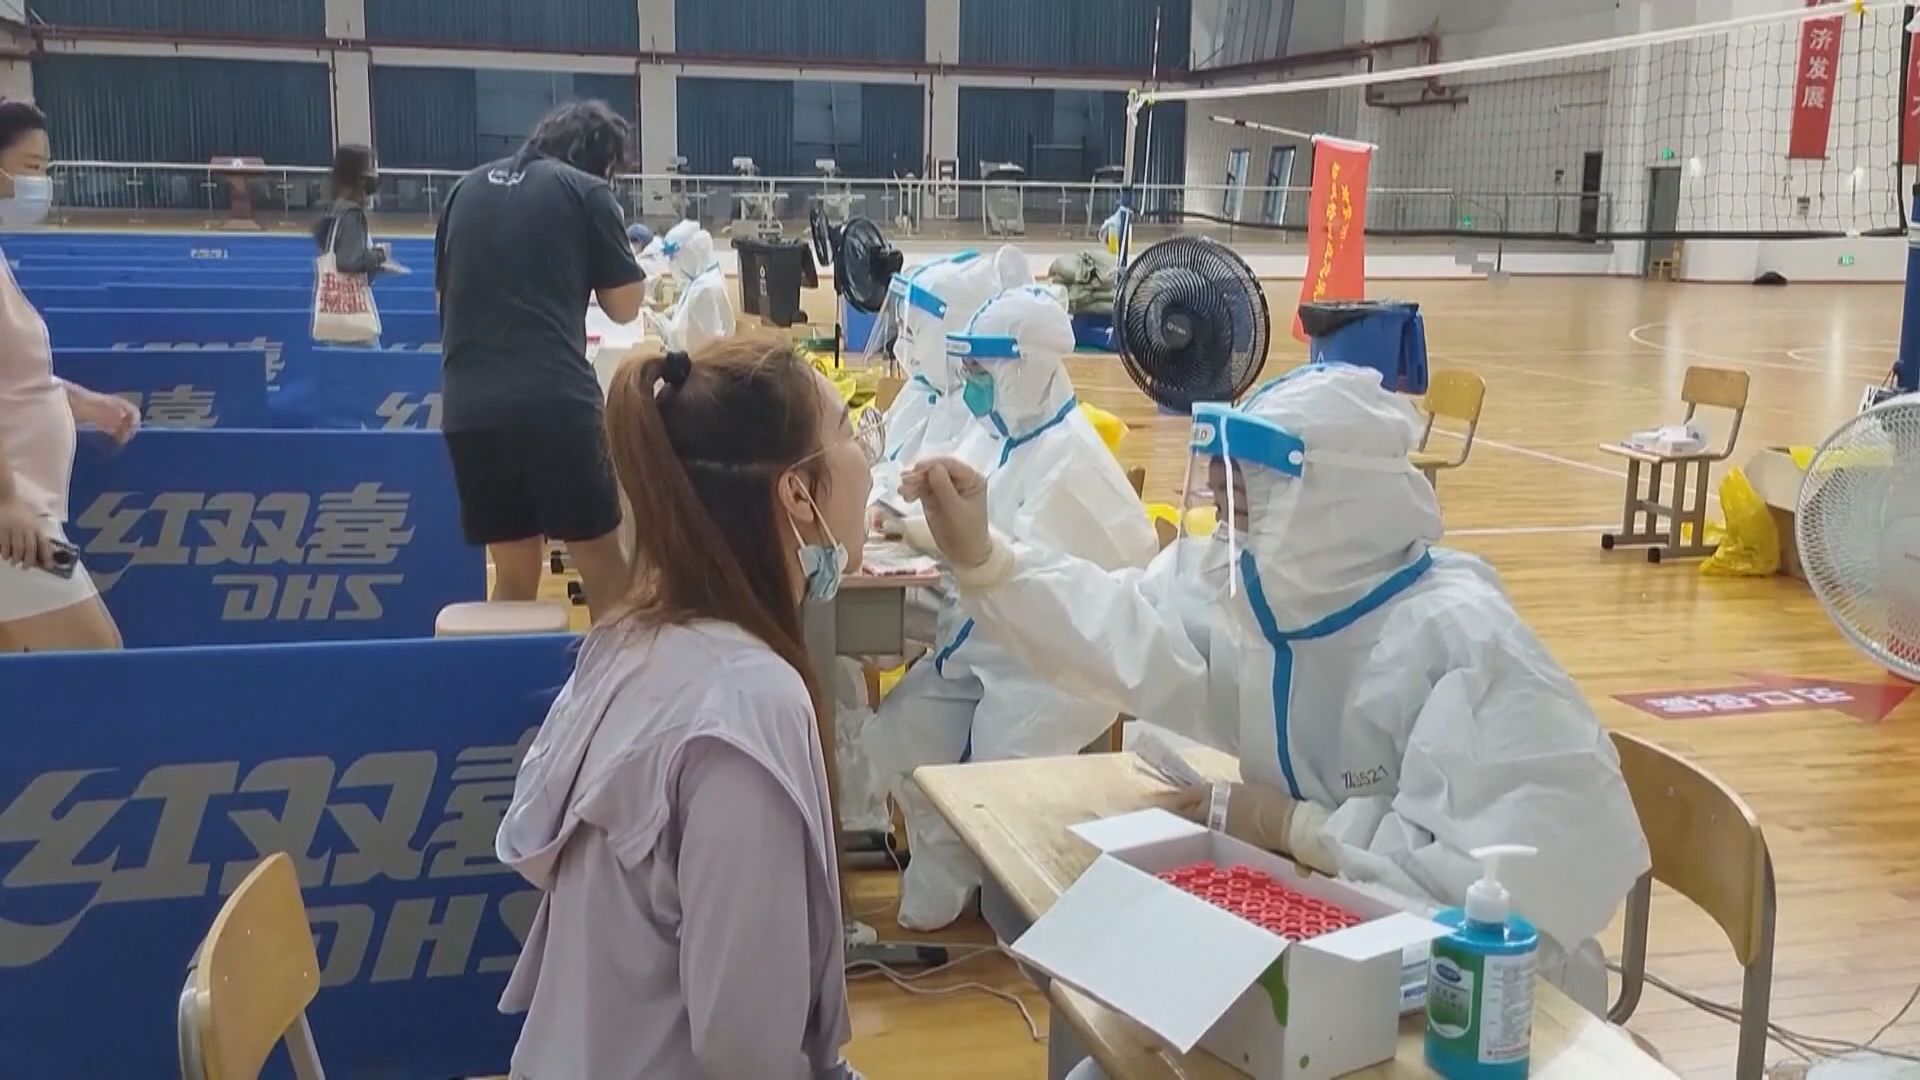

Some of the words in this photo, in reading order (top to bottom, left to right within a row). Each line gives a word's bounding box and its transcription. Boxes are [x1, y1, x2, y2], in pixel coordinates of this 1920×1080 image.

[76, 482, 415, 592] 红双喜
[211, 574, 404, 620] DHS
